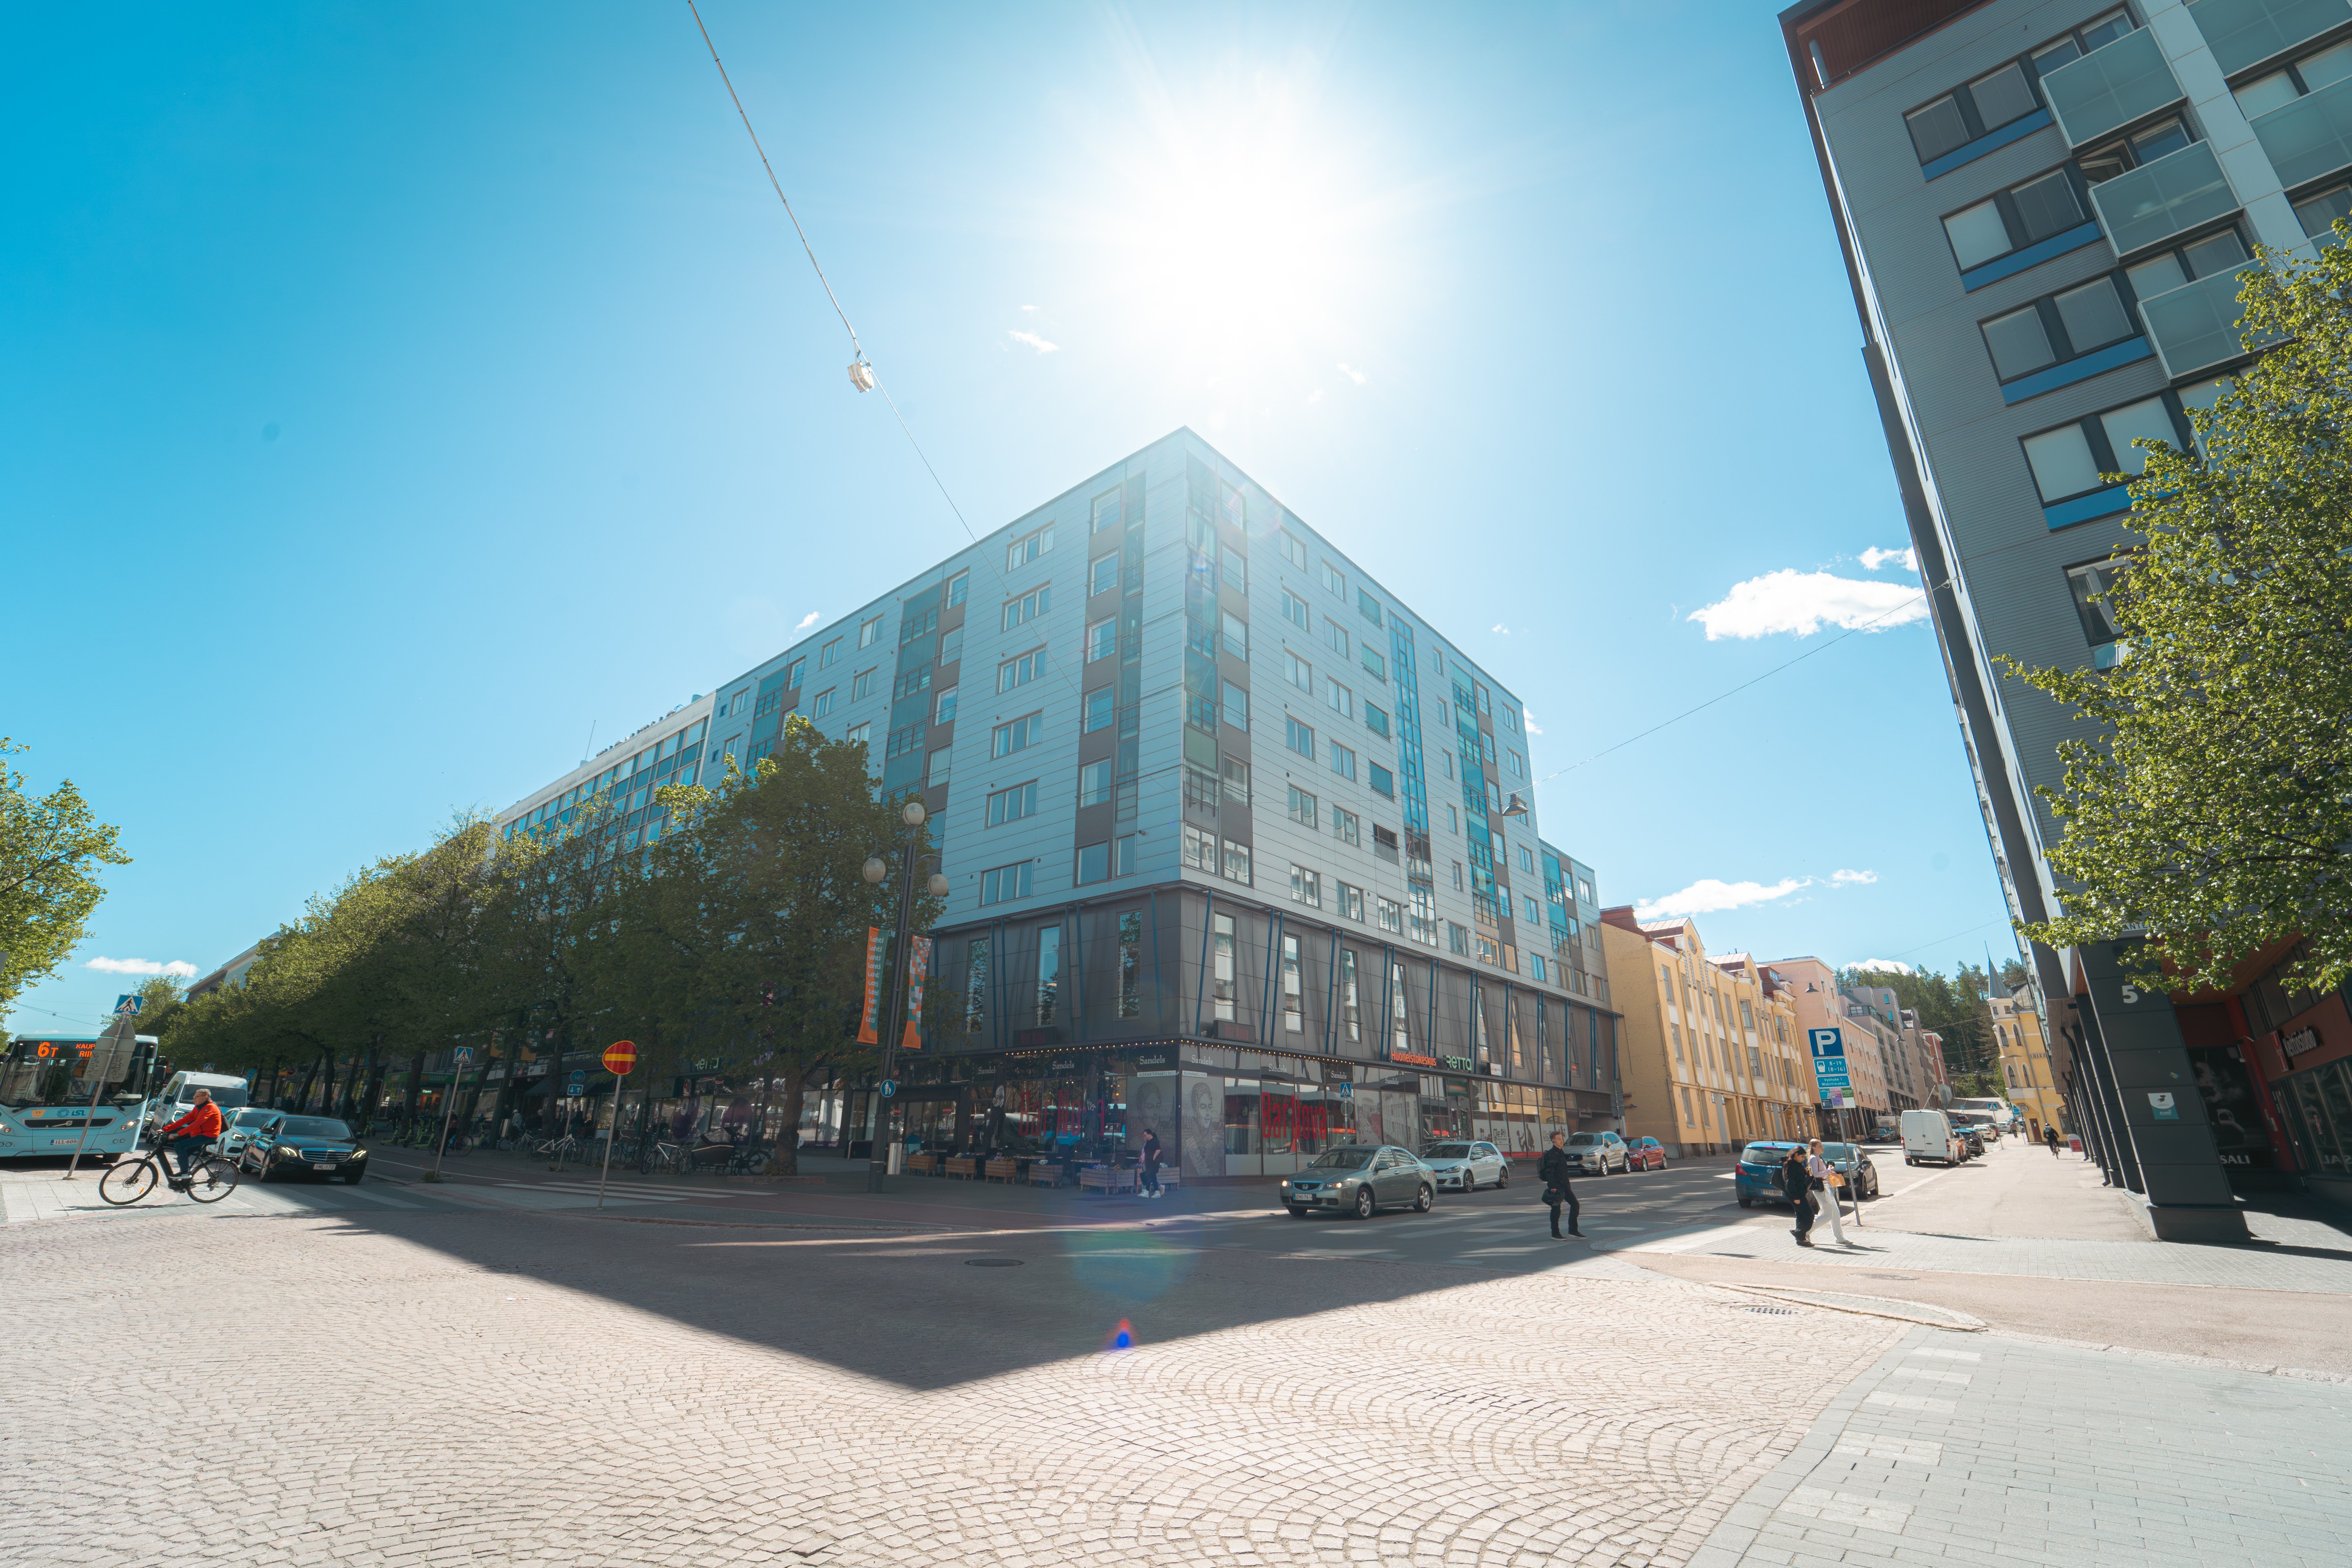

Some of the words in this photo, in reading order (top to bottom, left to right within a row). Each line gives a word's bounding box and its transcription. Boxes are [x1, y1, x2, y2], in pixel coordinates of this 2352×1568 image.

[2122, 985, 2138, 1003] 5
[1815, 1031, 1836, 1055] P
[1139, 1054, 1165, 1065] Sandels
[1191, 1054, 1213, 1065] Sandels
[1391, 1049, 1437, 1067] Huoneistokeskus
[978, 1066, 996, 1074] Sandel
[1052, 1060, 1074, 1070] Sandels
[1268, 1063, 1287, 1073] Sandels
[1331, 1070, 1347, 1080] Sandels
[1385, 1076, 1399, 1085] Sandels
[1019, 1091, 1050, 1136] Bar
[1262, 1092, 1288, 1138] Bar
[1291, 1094, 1326, 1140] Nova
[2220, 1155, 2251, 1164] SALI
